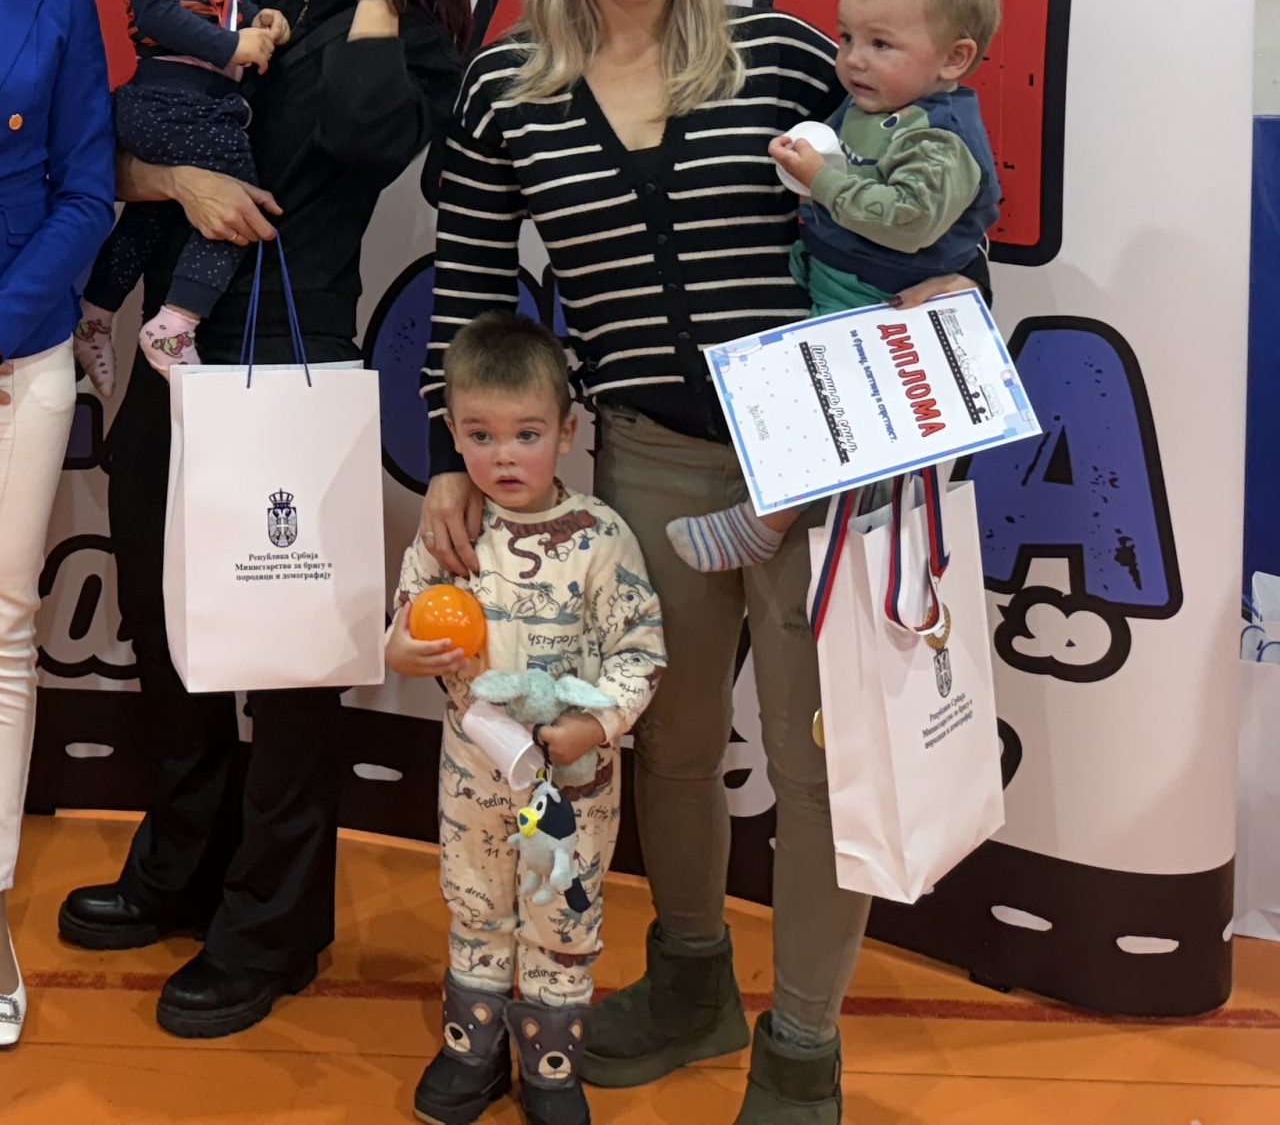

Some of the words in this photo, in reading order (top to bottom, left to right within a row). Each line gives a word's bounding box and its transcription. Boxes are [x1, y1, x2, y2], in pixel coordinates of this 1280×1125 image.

[877, 323, 946, 438] ДИПЛОМА
[810, 344, 841, 408] Породица
[834, 419, 858, 454] срцу
[248, 553, 289, 562] Република
[291, 552, 318, 561] Србија
[235, 563, 291, 572] Министарство
[303, 562, 325, 570] бригу
[236, 573, 274, 582] породици
[282, 572, 331, 580] демографију
